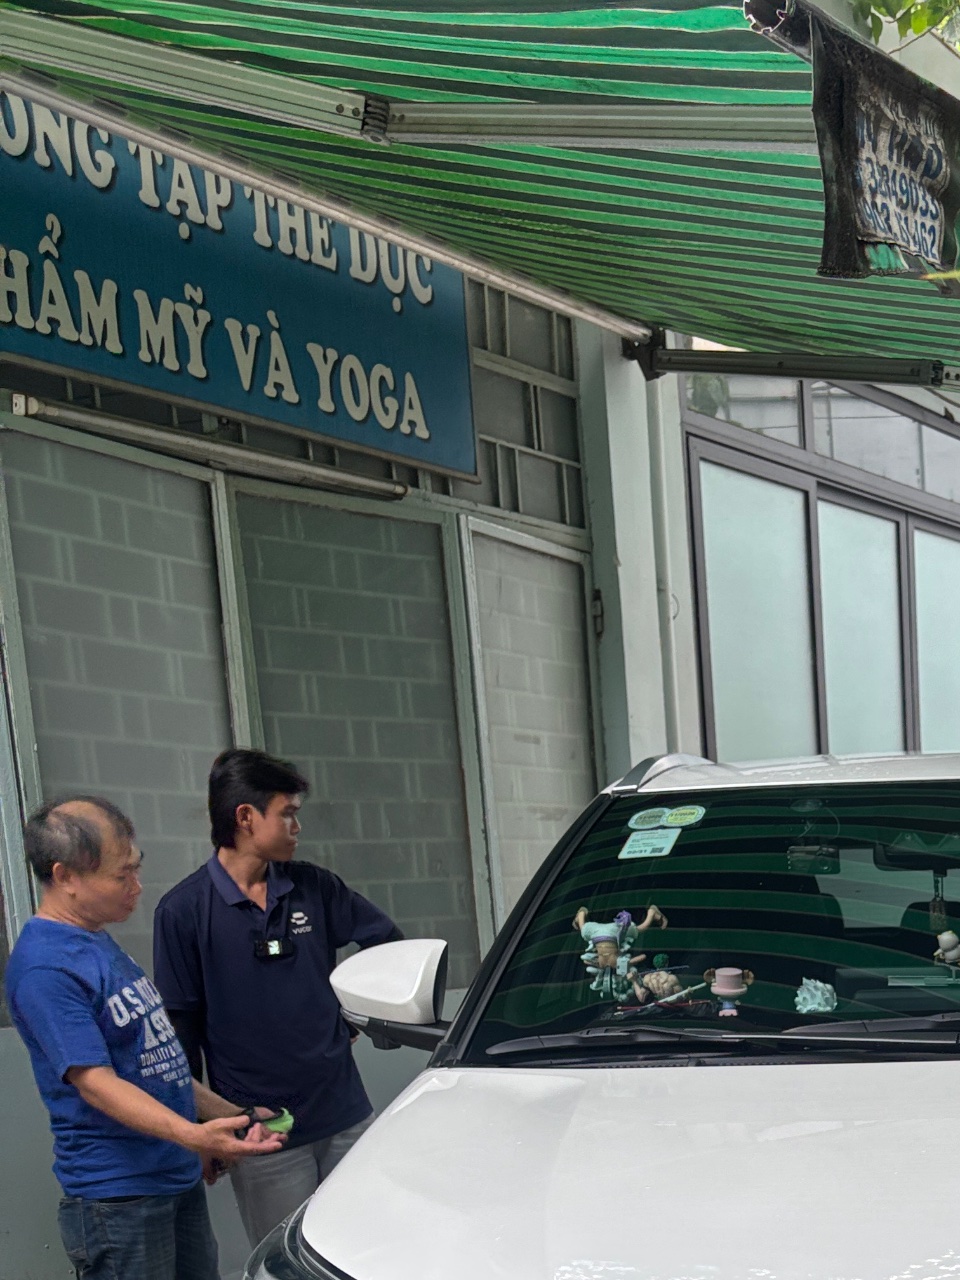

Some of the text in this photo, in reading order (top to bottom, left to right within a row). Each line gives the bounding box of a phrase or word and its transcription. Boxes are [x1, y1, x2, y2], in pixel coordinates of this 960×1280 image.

[133, 283, 211, 378] MỸ
[225, 310, 299, 404] VÀ
[306, 342, 430, 440] YOGA
